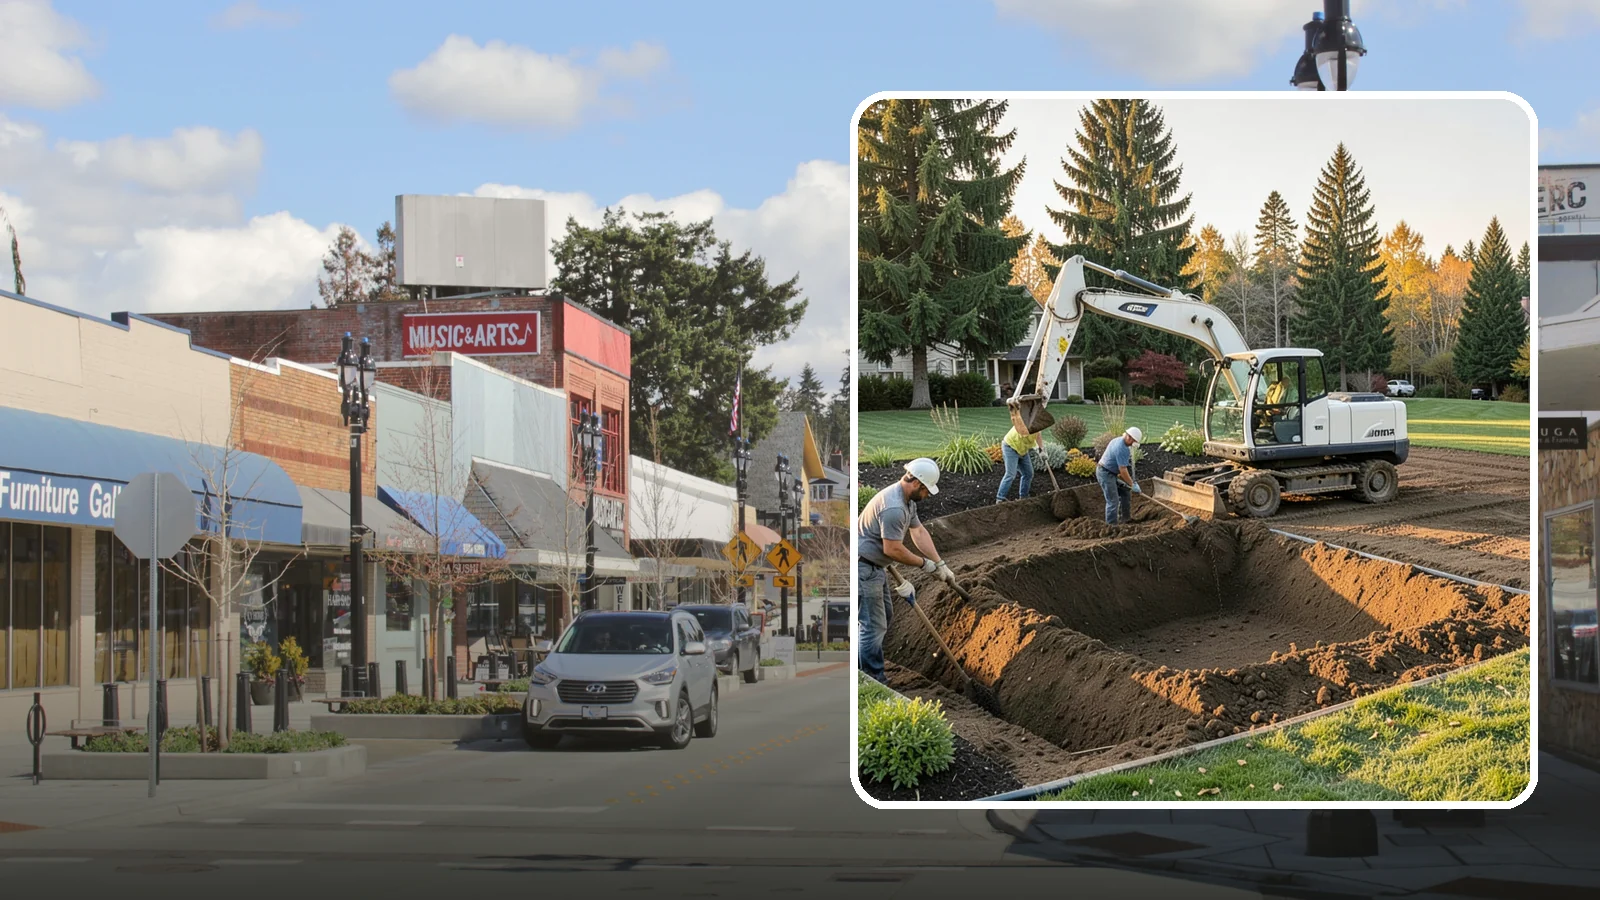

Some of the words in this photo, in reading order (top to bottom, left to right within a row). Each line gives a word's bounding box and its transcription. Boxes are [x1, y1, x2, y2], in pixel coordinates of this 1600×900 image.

[409, 322, 519, 348] MUSIC&ARTS
[0, 472, 79, 515] Furniture
[452, 563, 479, 574] SUSHI
